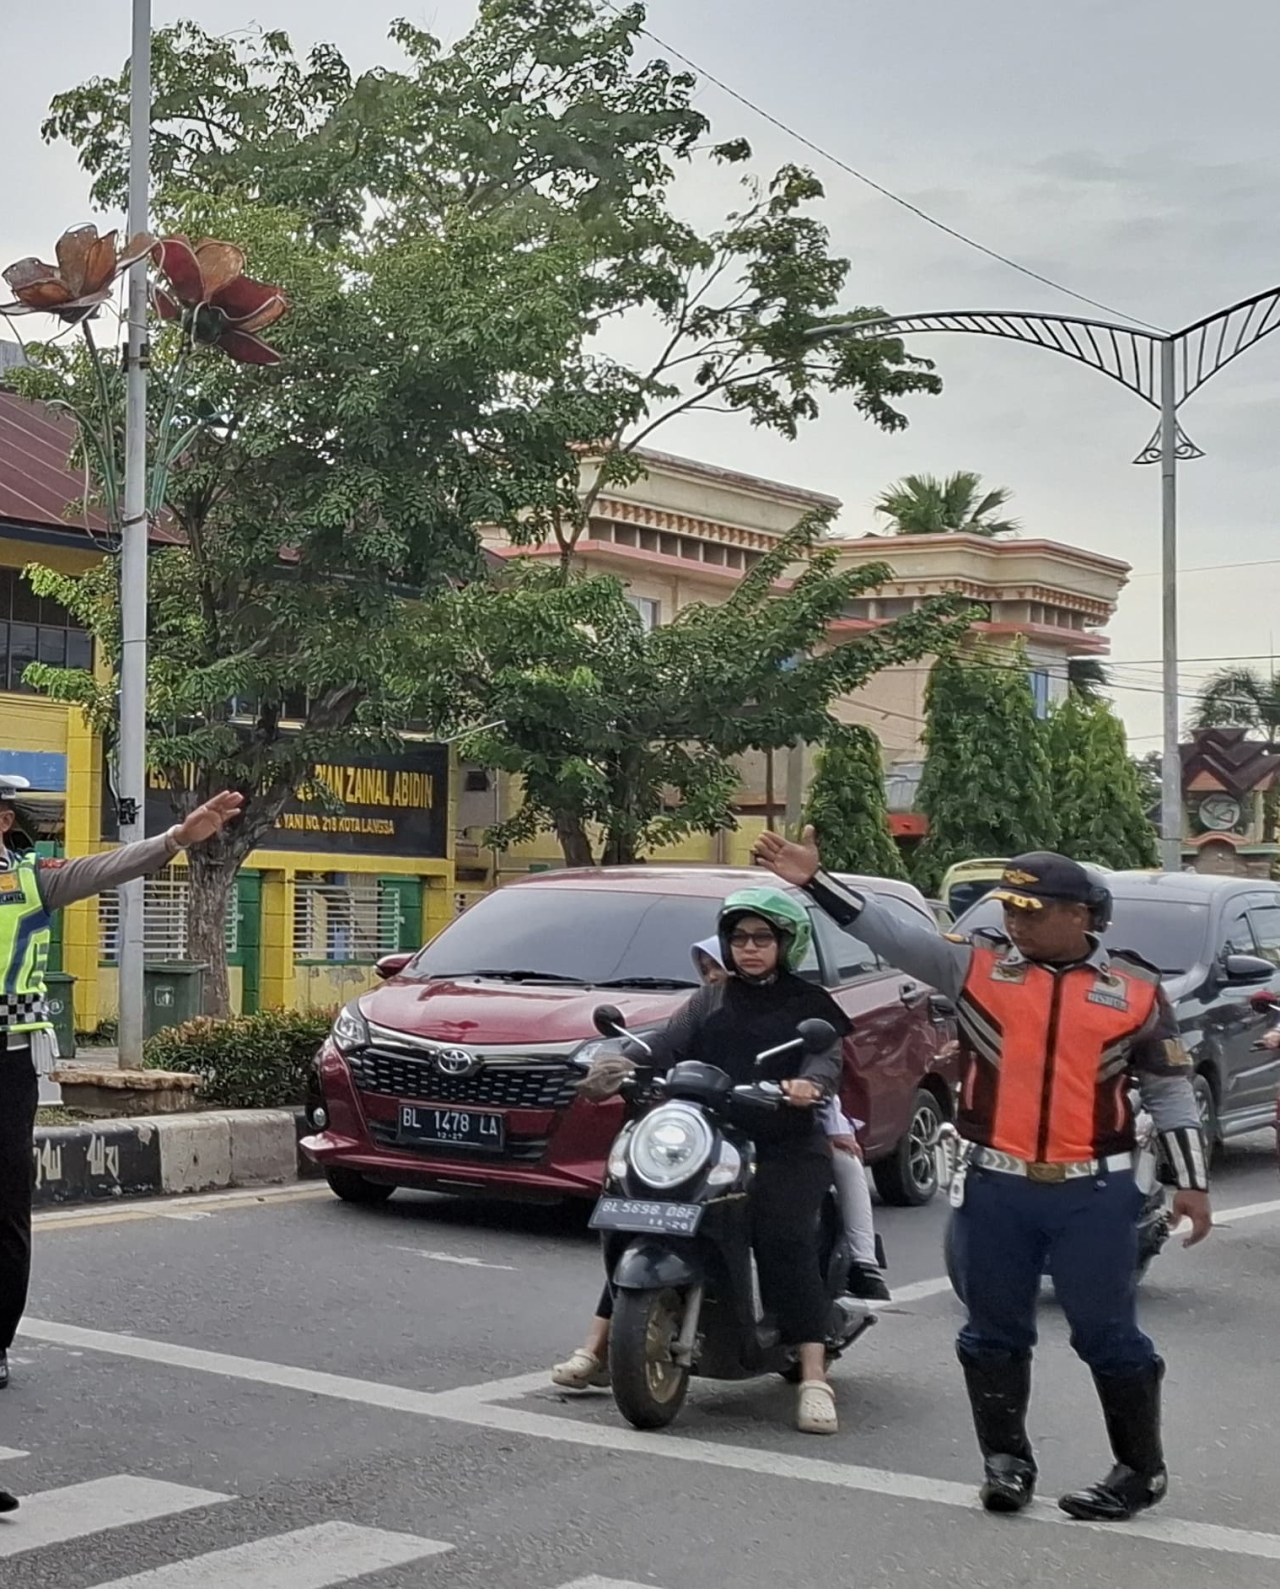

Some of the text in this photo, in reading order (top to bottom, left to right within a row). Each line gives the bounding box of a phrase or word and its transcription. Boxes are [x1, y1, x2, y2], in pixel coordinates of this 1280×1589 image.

[346, 767, 390, 805] ZAINAL
[392, 771, 433, 809] ABIDIN
[339, 817, 360, 833] KOTA
[403, 1107, 497, 1136] BL 1478 LA
[602, 1201, 619, 1213] BL
